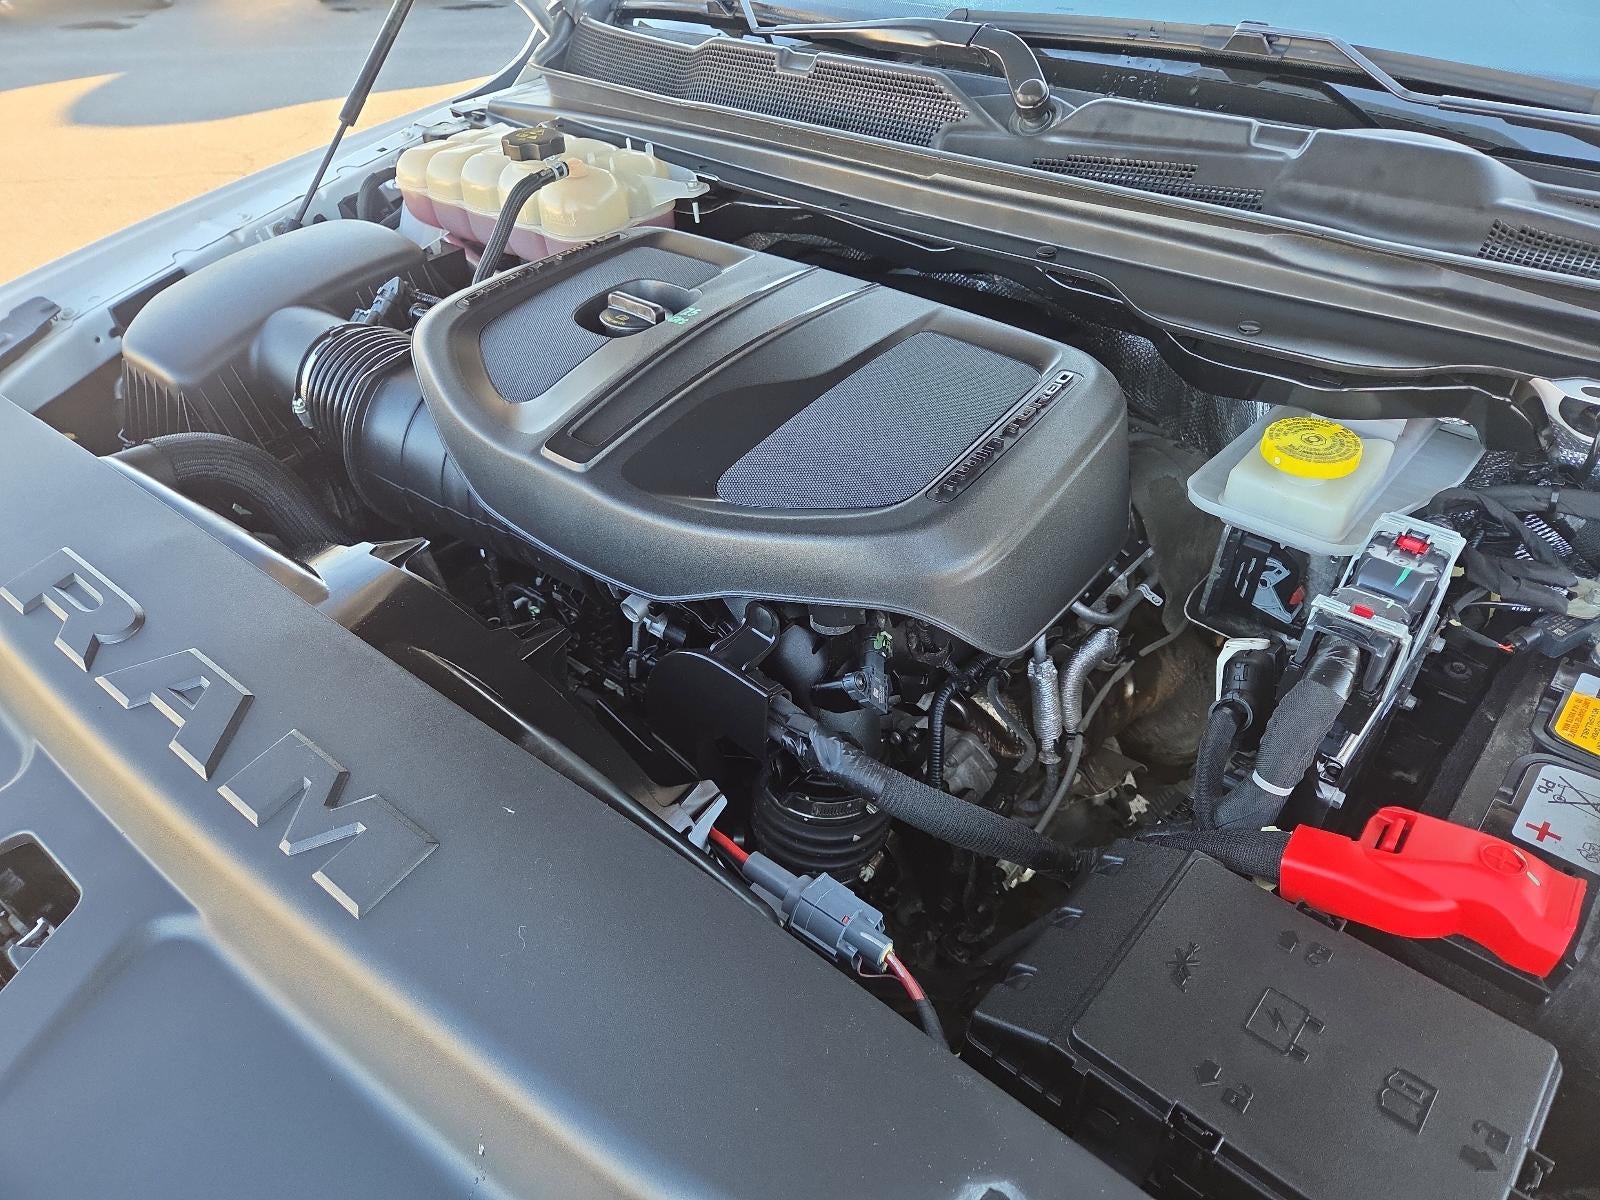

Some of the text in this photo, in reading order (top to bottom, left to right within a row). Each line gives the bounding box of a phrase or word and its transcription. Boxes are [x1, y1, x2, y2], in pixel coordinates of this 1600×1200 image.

[934, 371, 1075, 495] TWIN TURBO
[0, 545, 441, 921] RAM
